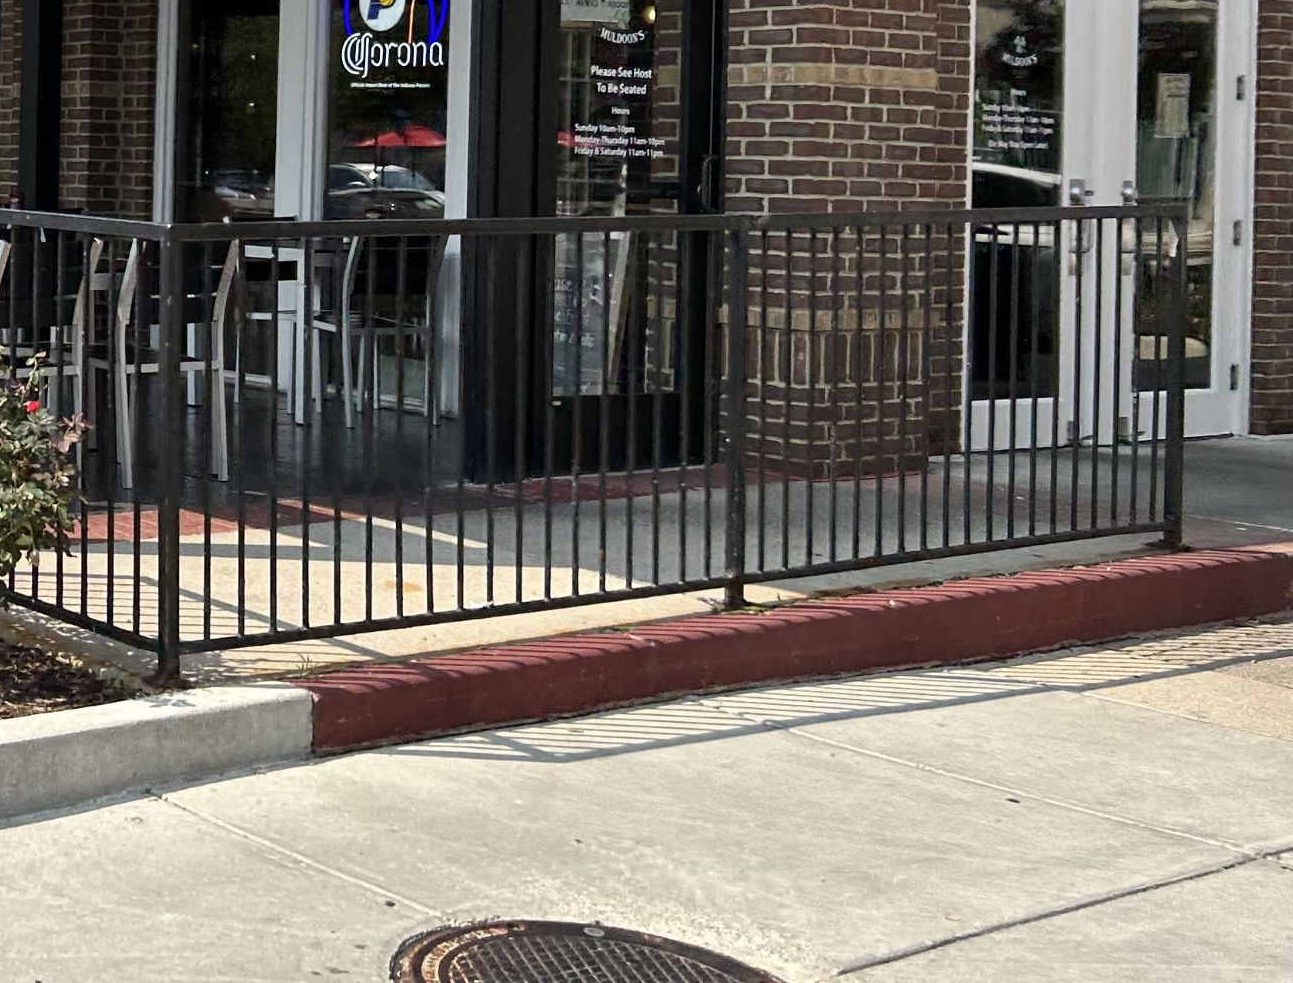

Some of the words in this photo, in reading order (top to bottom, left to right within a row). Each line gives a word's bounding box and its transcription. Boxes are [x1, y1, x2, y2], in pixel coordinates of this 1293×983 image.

[599, 27, 646, 44] MULDOON'S
[341, 32, 444, 79] Corona
[590, 64, 617, 78] Please
[617, 67, 633, 78] See
[633, 68, 653, 79] Host
[596, 82, 607, 93] To
[607, 83, 619, 94] Be
[619, 83, 647, 95] Seated
[611, 106, 631, 115] Hours
[574, 123, 598, 134] Sunday
[599, 124, 636, 135] 10am-10pm
[629, 136, 666, 147] 11am-10pm
[574, 146, 594, 157] Friday
[594, 147, 600, 156] &
[600, 147, 628, 158] Saturday
[628, 148, 664, 159] 11am-11pm
